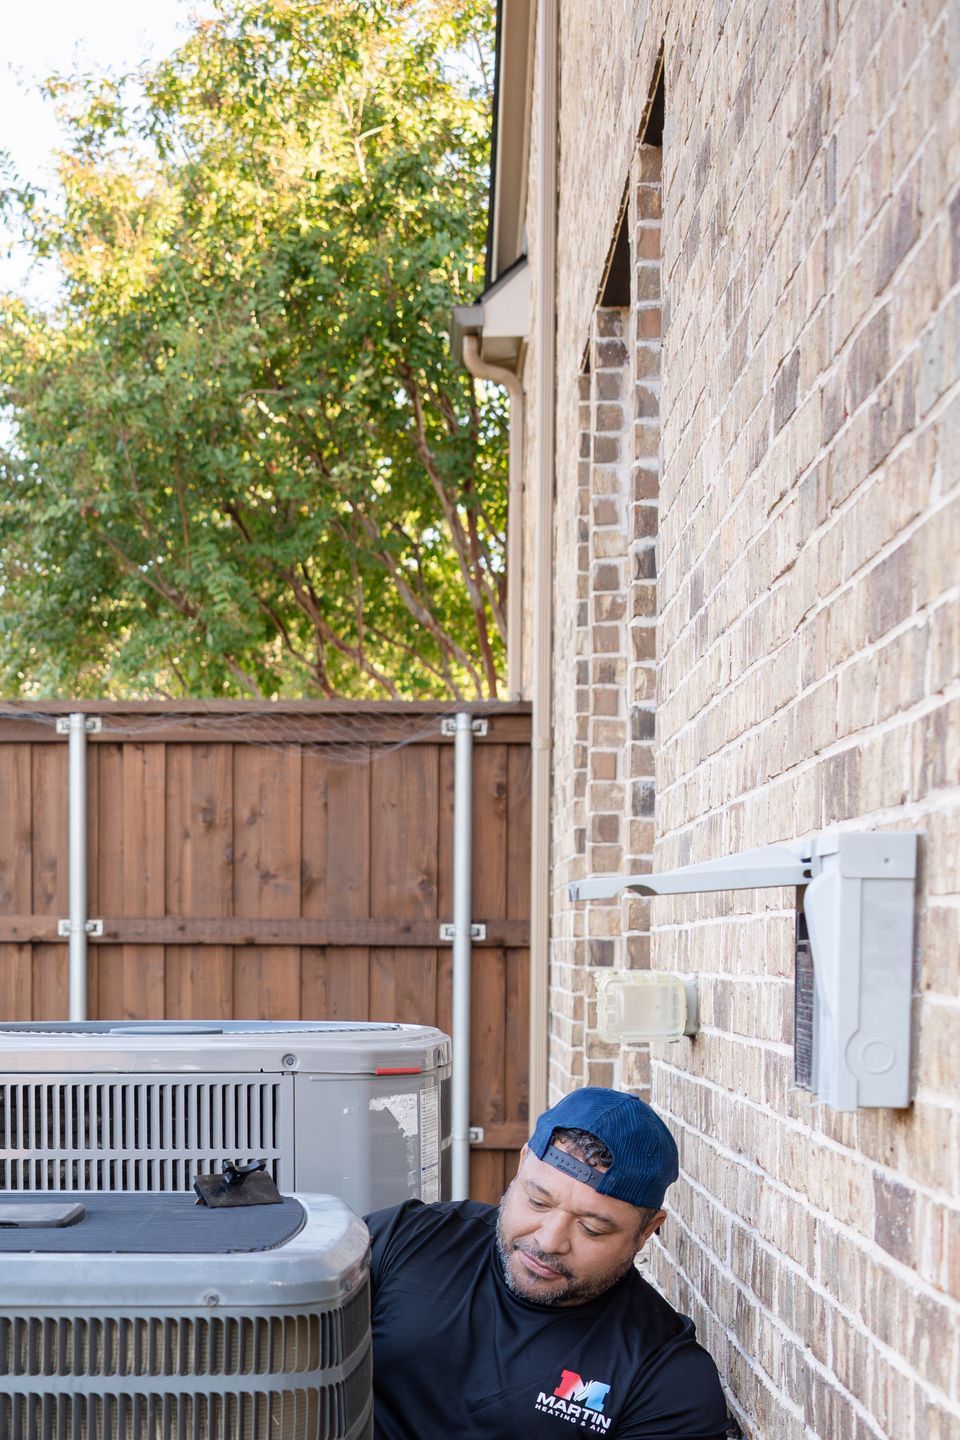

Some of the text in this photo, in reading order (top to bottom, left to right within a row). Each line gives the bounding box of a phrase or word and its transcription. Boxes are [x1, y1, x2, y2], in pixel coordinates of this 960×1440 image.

[535, 1404, 576, 1423] HEATING
[589, 1424, 607, 1435] AIR
[536, 1391, 612, 1430] MARTIN
